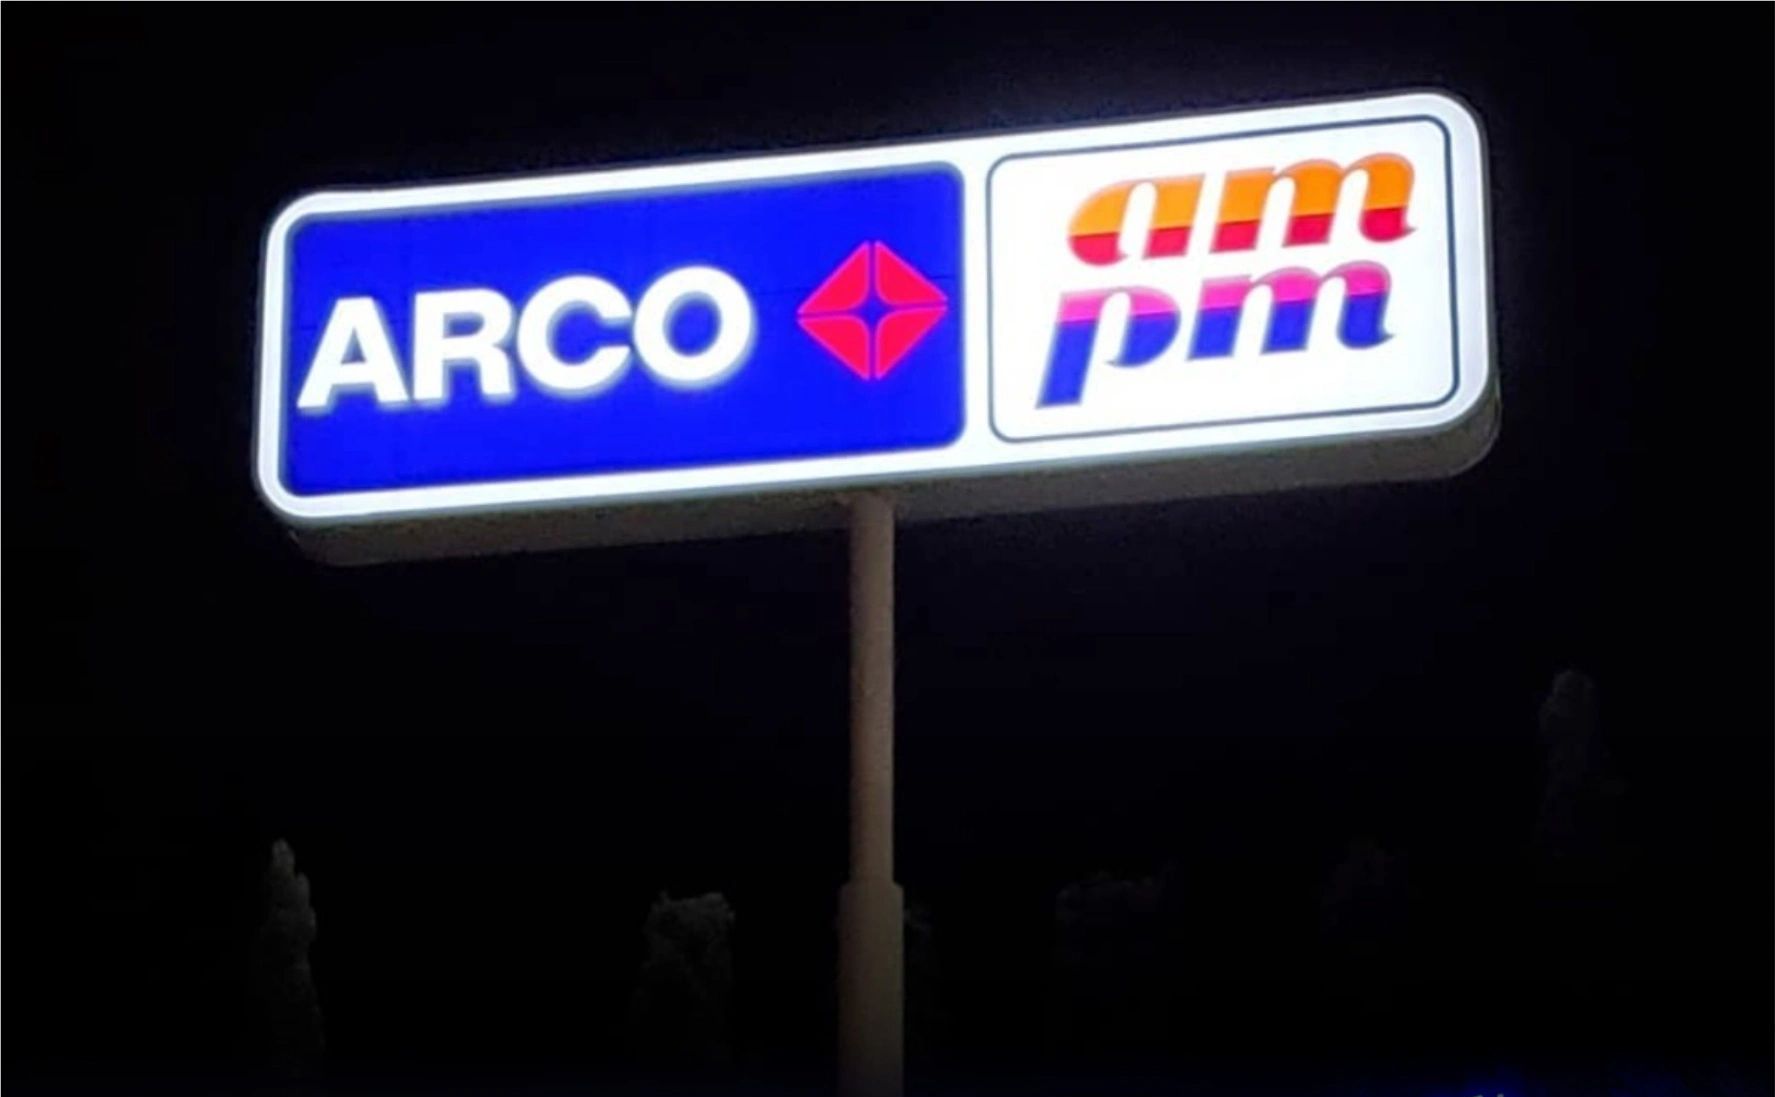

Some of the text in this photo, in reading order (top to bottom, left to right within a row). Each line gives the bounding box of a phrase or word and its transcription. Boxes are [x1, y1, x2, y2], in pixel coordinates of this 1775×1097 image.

[1066, 150, 1416, 266] am
[296, 264, 756, 412] ARCO
[1034, 258, 1394, 410] pm
